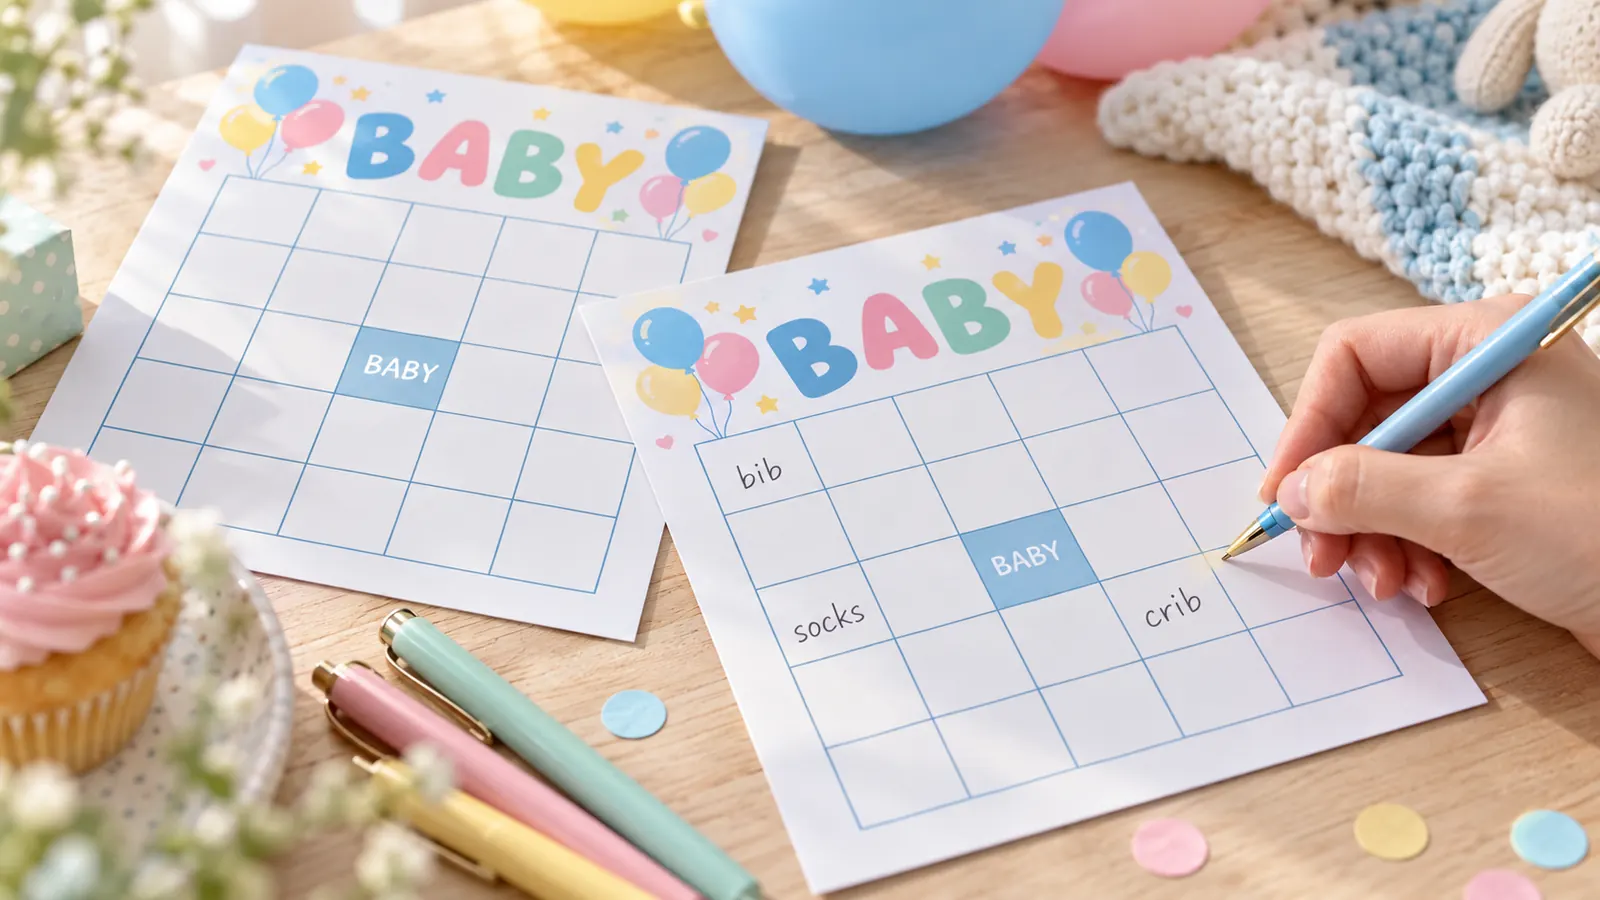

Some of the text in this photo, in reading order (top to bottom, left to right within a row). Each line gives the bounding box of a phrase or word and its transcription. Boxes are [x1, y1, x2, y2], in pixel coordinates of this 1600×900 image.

[346, 112, 645, 213] BABY
[766, 261, 1063, 398] BABY
[364, 354, 439, 383] BABY
[737, 457, 782, 490] bib
[991, 540, 1061, 576] BABY
[794, 602, 865, 643] socks
[1145, 588, 1202, 628] crib
